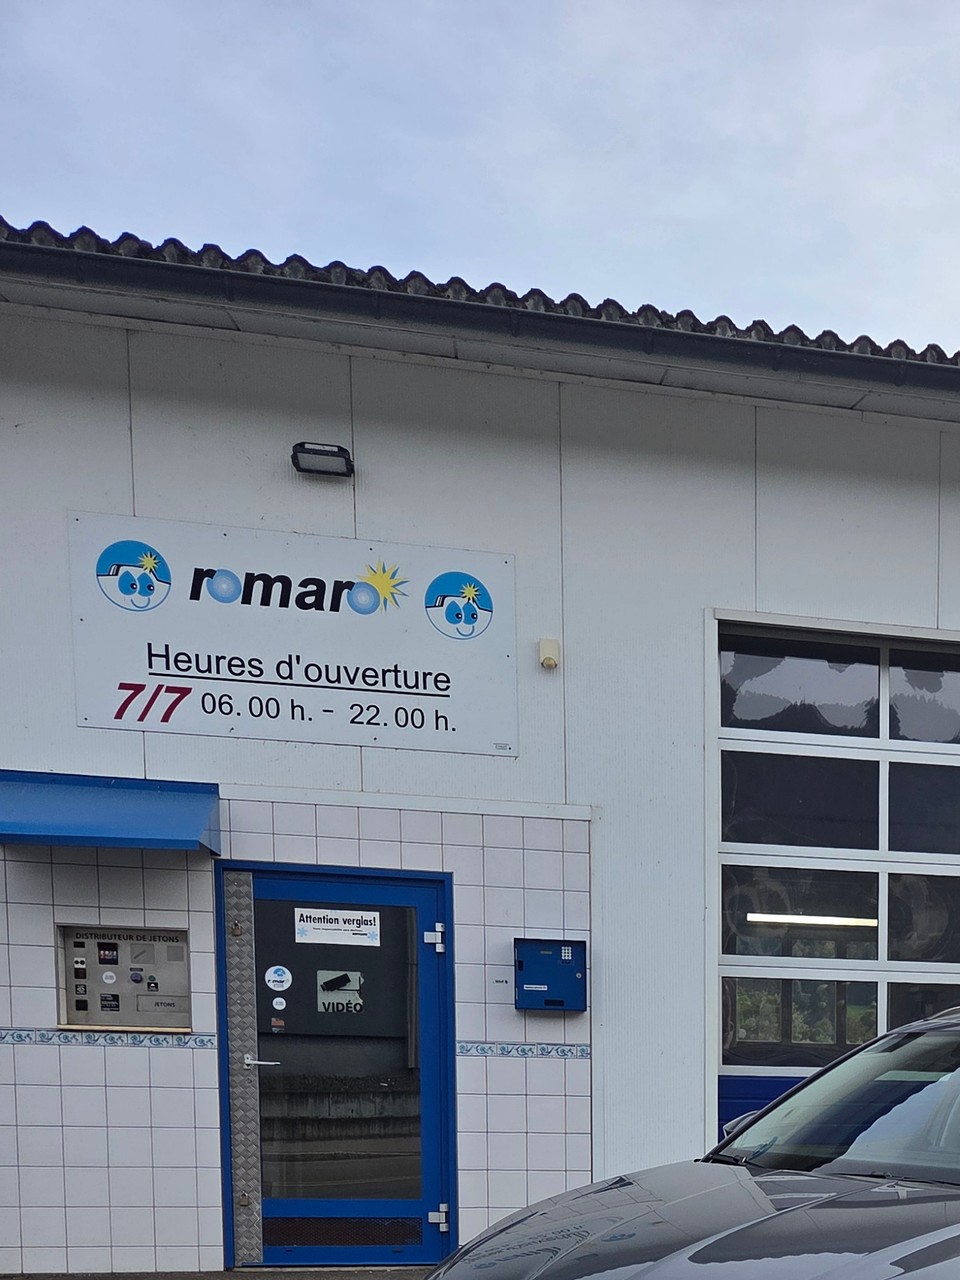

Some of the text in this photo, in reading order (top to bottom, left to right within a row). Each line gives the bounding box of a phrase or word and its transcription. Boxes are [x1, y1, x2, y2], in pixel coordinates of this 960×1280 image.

[189, 568, 381, 615] romaro
[146, 642, 451, 692] Heures d'ouverture
[113, 682, 193, 724] 7/7
[299, 913, 376, 929] Attention verglas!
[75, 932, 134, 942] DISTRIBUTEUR
[322, 1000, 364, 1013] VIDÉO
